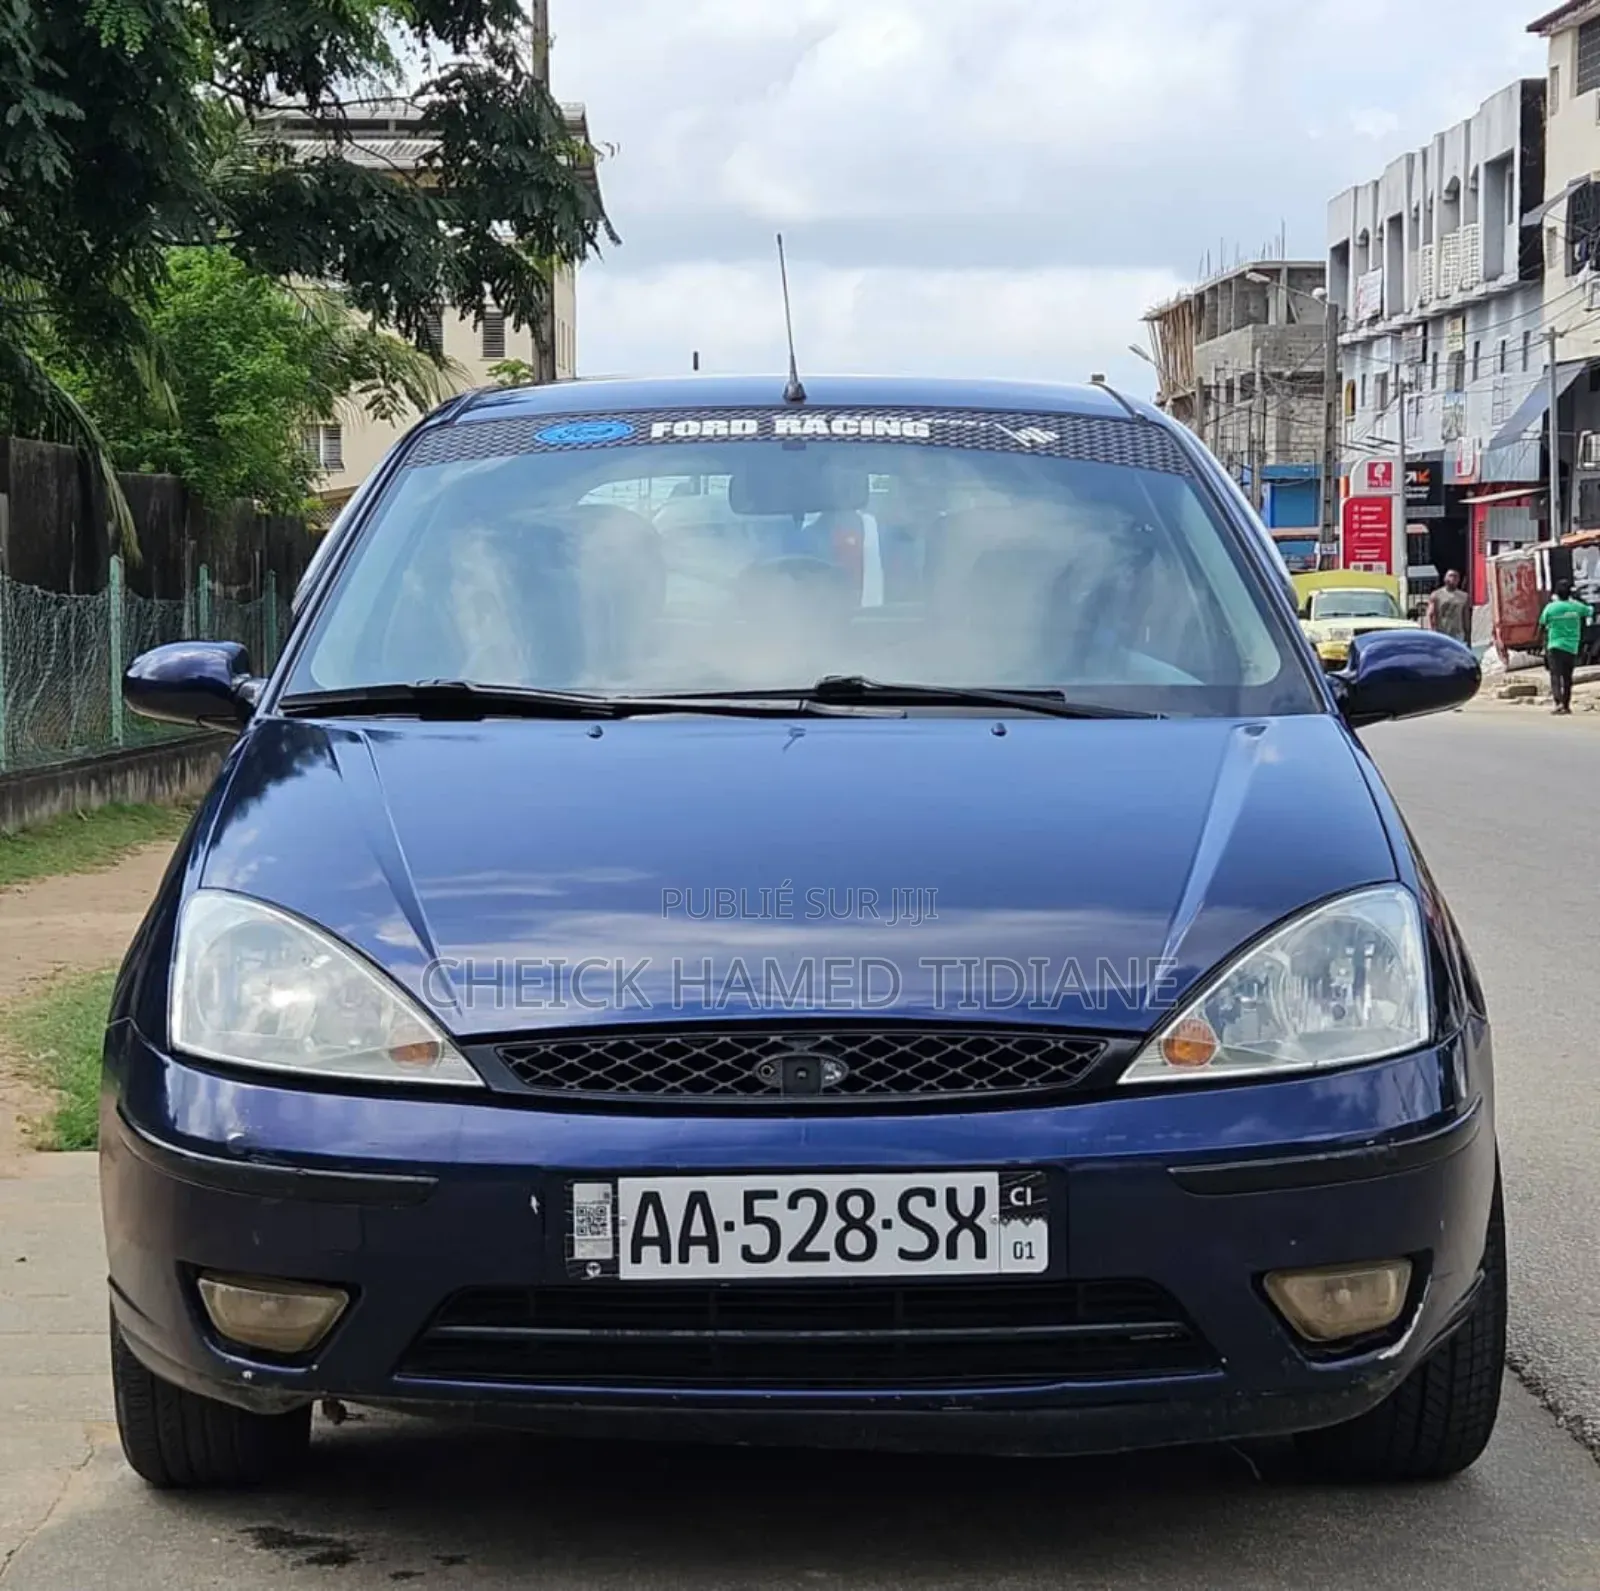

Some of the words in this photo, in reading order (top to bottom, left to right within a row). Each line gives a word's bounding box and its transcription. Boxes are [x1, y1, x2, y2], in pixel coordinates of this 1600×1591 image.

[650, 419, 759, 441] FORD
[773, 416, 932, 439] RACING
[1010, 1187, 1032, 1206] CI
[1012, 1240, 1035, 1260] 01
